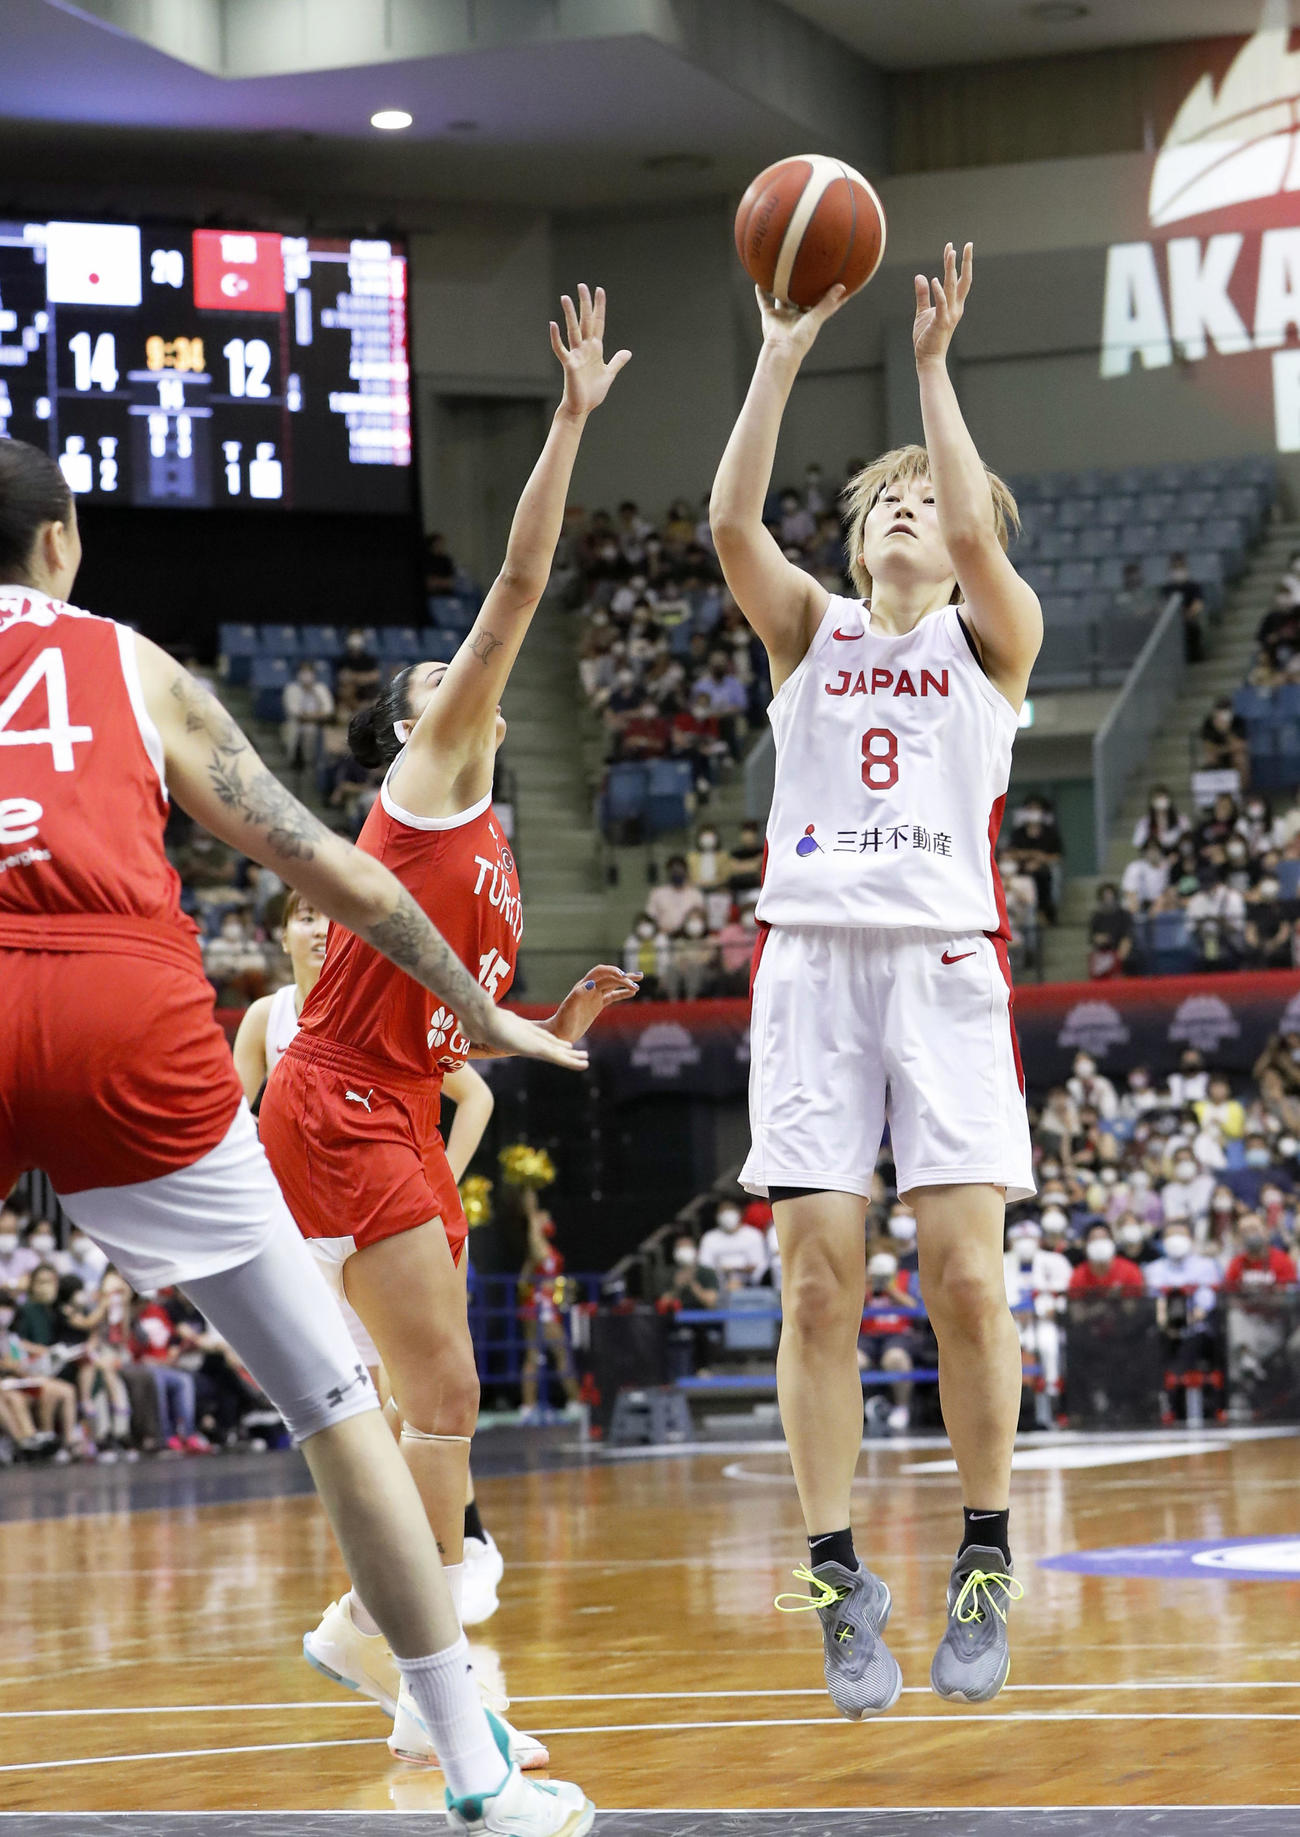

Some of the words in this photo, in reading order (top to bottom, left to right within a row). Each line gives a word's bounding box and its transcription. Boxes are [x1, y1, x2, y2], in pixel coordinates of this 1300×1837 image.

[68, 331, 119, 392] 14
[223, 338, 271, 398] 12
[825, 668, 949, 698] JAPAN
[861, 727, 899, 791] 8
[832, 824, 953, 858] 三井不動産
